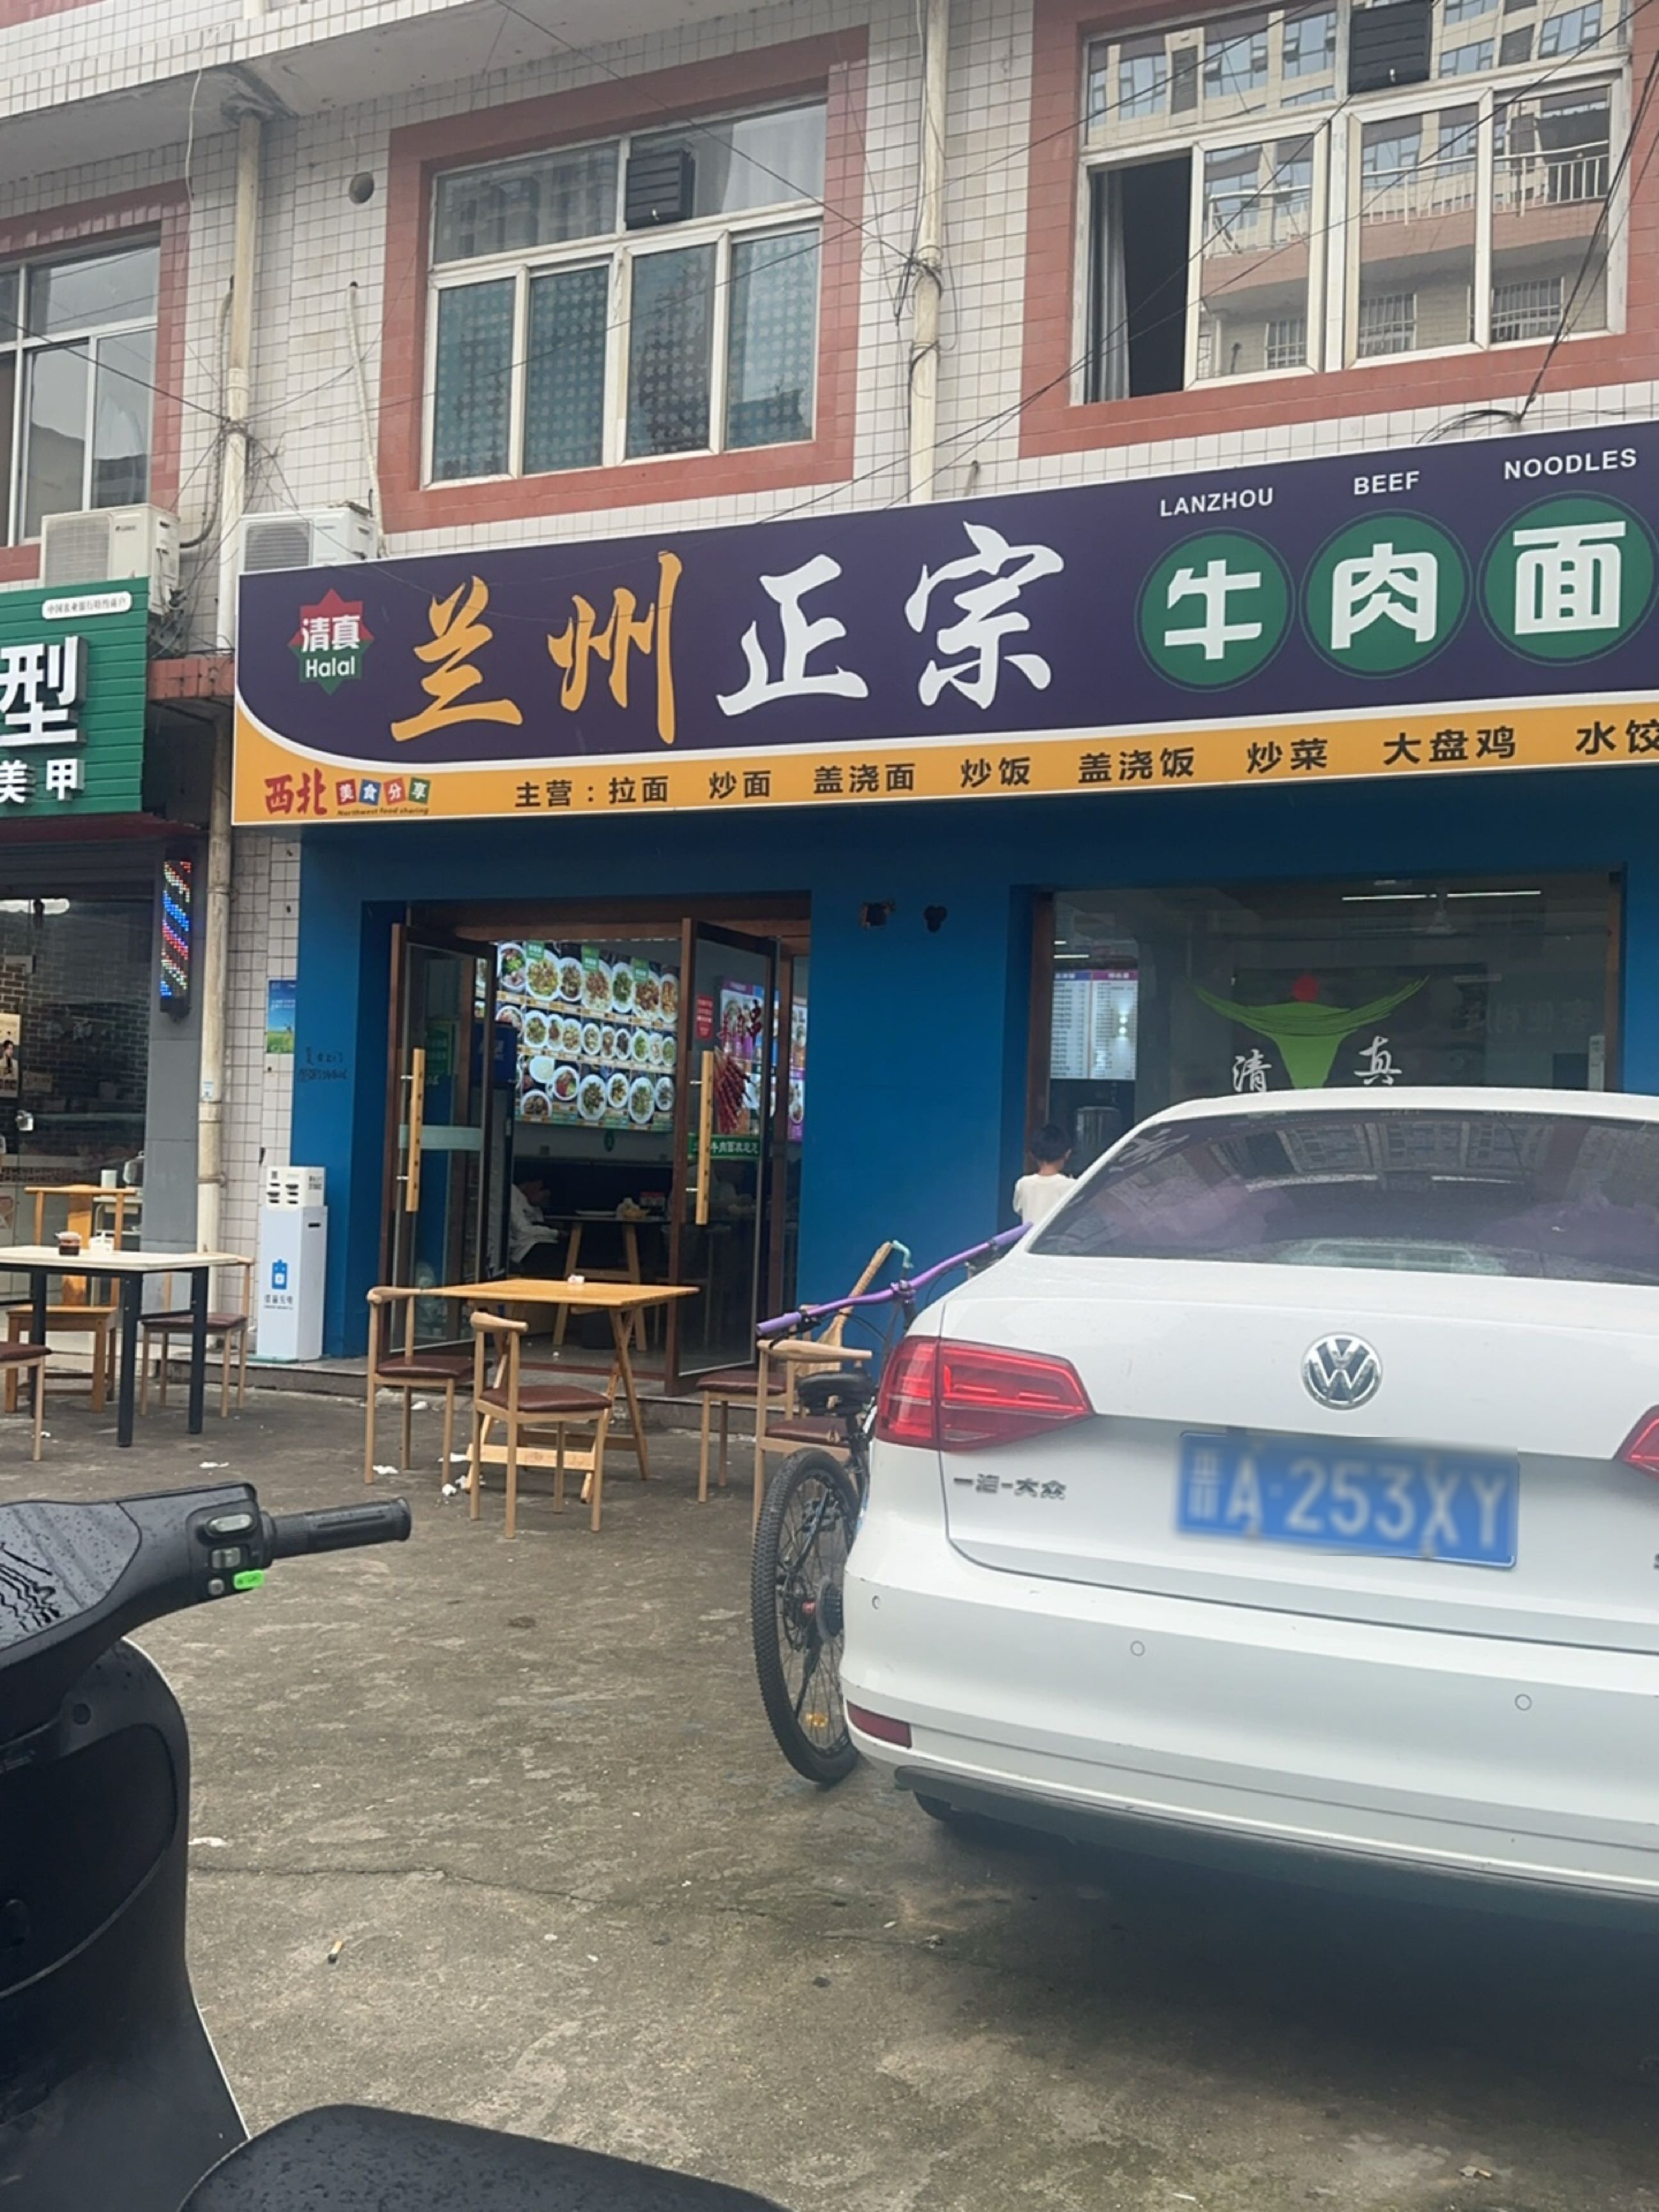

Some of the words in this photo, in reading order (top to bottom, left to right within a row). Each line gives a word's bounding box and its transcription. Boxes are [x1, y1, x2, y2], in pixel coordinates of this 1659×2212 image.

[1160, 488, 1274, 517] LANZHOU
[1354, 470, 1420, 495] BEEF
[1504, 448, 1637, 480] NOODLES
[301, 614, 360, 652] 清真
[391, 519, 1064, 744] 兰州正宗
[1164, 520, 1627, 660] 牛肉面
[0, 636, 79, 747] 型
[305, 656, 356, 678] Halal
[0, 758, 79, 803] 美甲
[709, 770, 772, 801] 炒面
[813, 762, 916, 795] 盖浇面
[960, 756, 1031, 789] 炒饭
[1077, 746, 1196, 784] 盖浇饭
[1246, 737, 1329, 774] 炒菜
[1382, 725, 1516, 766] 大盘鸡
[1575, 718, 1659, 756] 水饺
[264, 768, 328, 815] 西北
[337, 779, 429, 804] 美食分享
[379, 807, 398, 815] food
[399, 807, 429, 817] sharing
[1231, 1048, 1272, 1093] 清
[1353, 1035, 1403, 1086] 真
